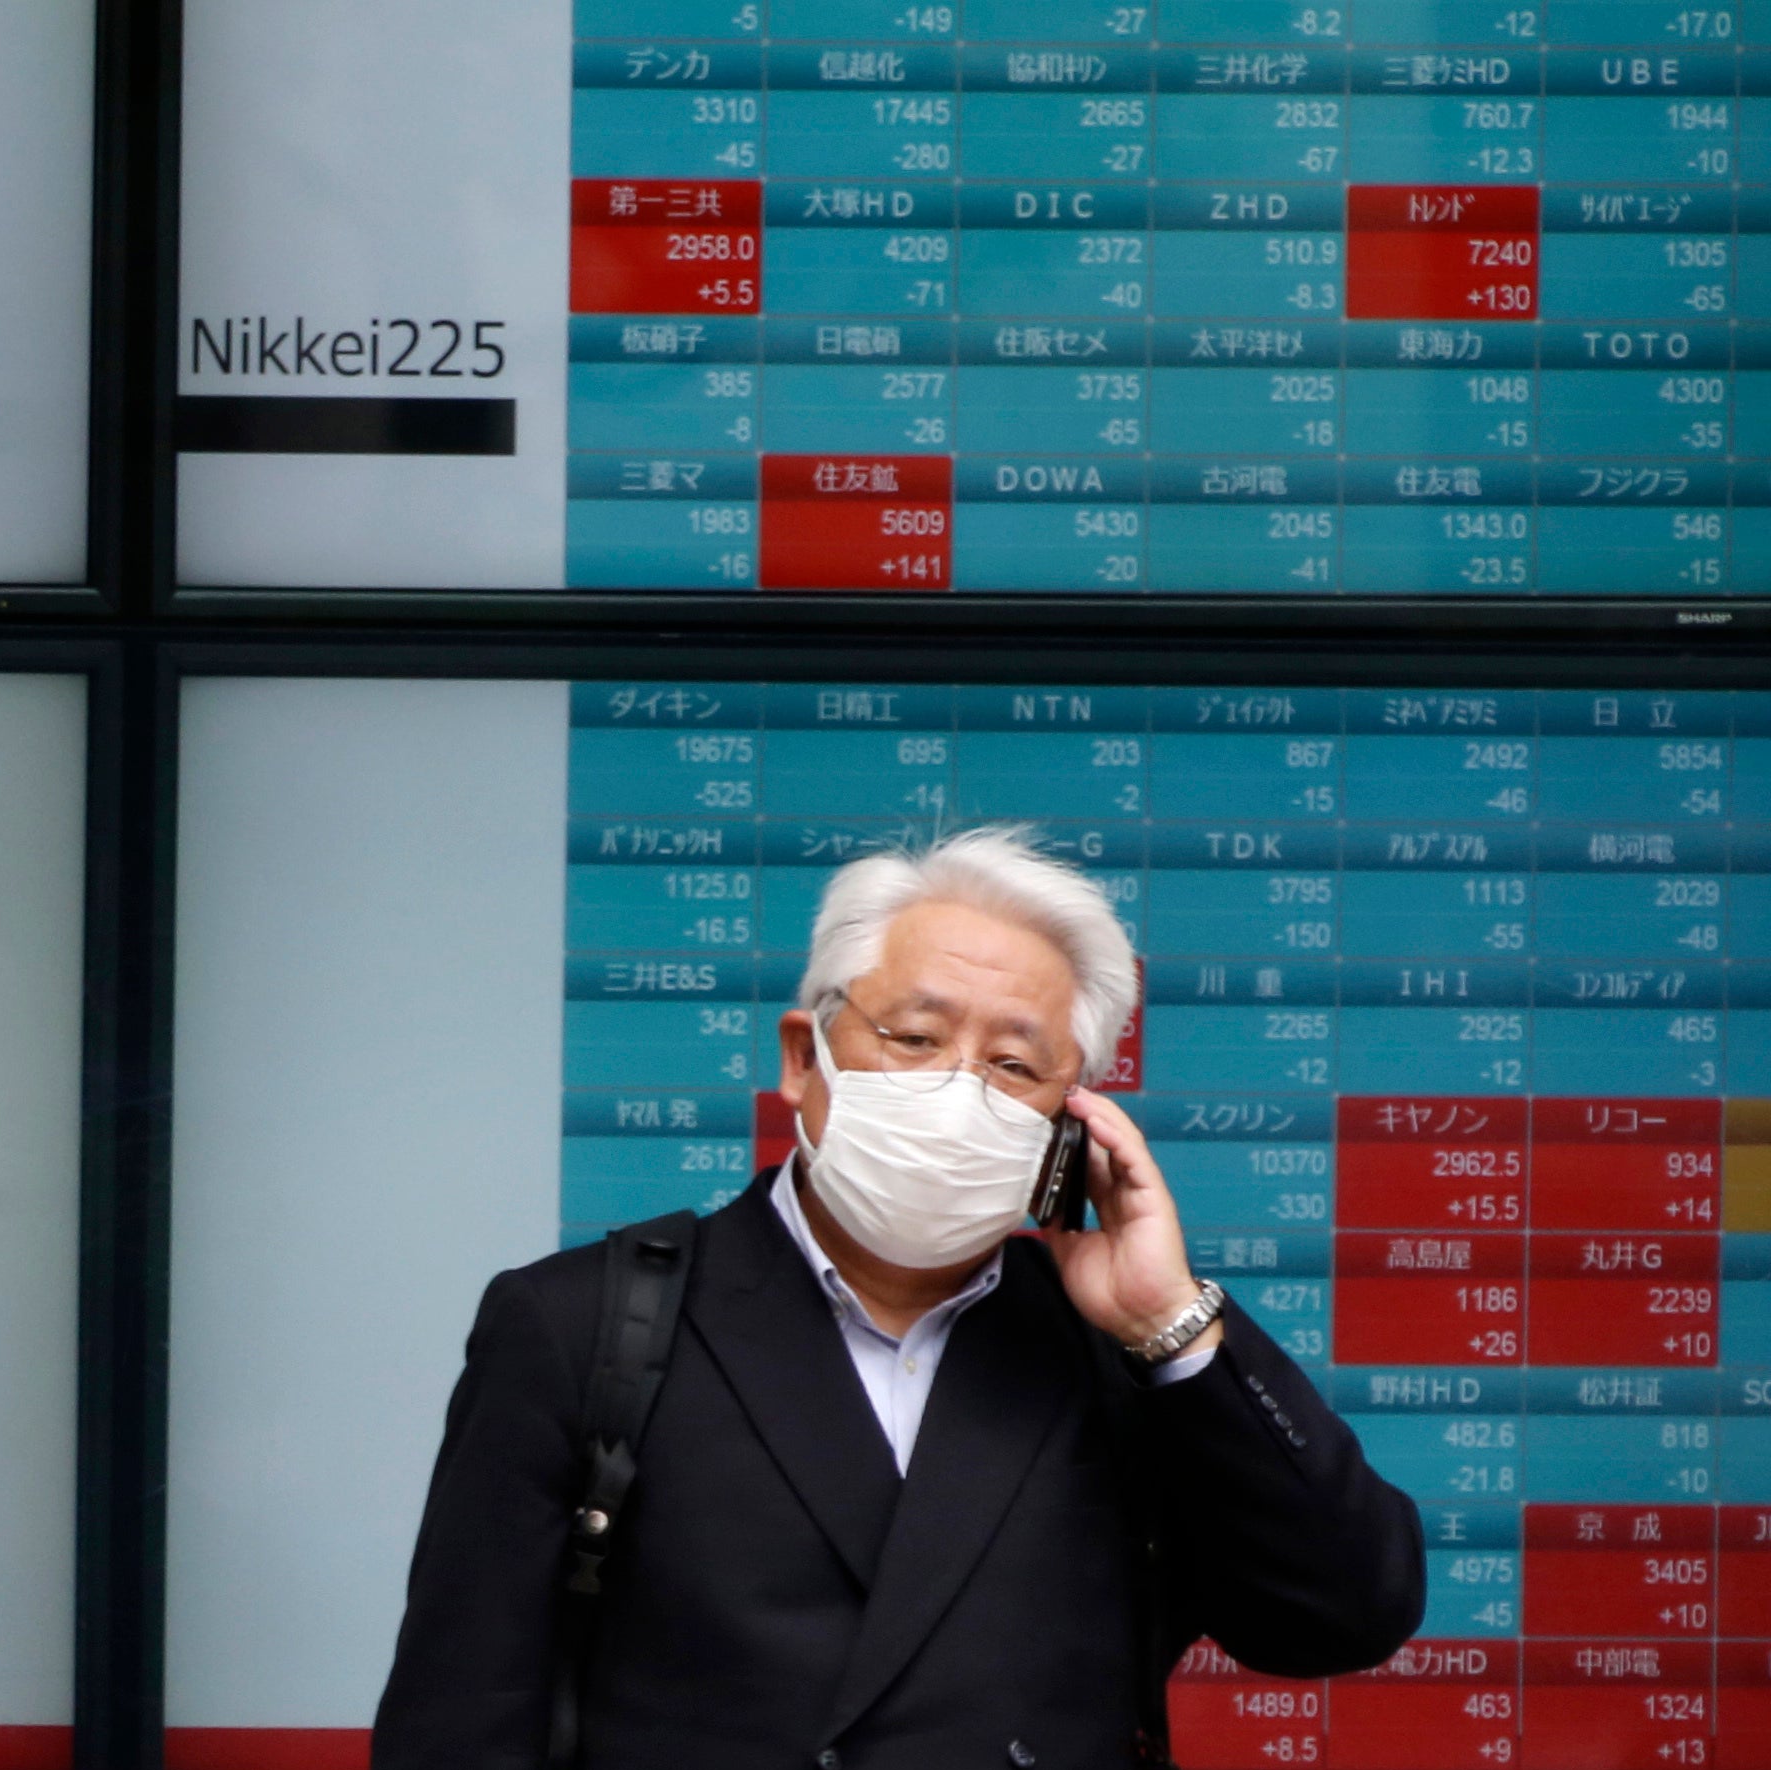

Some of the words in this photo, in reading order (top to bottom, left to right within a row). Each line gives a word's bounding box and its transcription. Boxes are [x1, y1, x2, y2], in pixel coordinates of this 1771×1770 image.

[731, 4, 759, 31] -5
[896, 6, 952, 33] -149
[1105, 7, 1147, 34] -27
[1293, 8, 1341, 36] -8.2
[1495, 10, 1536, 37] -12
[1666, 10, 1731, 38] -17.0
[694, 96, 756, 124] 3310
[875, 98, 950, 126] 17445
[1081, 100, 1144, 127] 2665
[1463, 102, 1534, 129] 760.7
[1668, 103, 1728, 130] 1944
[715, 142, 755, 168] -45
[894, 142, 950, 170] -280
[1102, 144, 1145, 172] -27
[1298, 146, 1339, 173] -67
[1468, 147, 1533, 174] -12.3
[1687, 148, 1729, 175] -10
[668, 234, 754, 260] 2958.0
[885, 235, 948, 262] 4209
[1080, 236, 1142, 264] 2372
[1266, 238, 1338, 265] 510.9
[1469, 240, 1531, 265] 7240
[1666, 240, 1726, 267] 1305
[699, 279, 753, 305] +5.5
[906, 279, 945, 306] -71
[1101, 282, 1142, 308] -40
[1288, 283, 1340, 310] -8.3
[1467, 285, 1530, 310] +130
[1684, 285, 1726, 311] -65
[192, 315, 506, 379] Nikkei225
[705, 371, 752, 398] 385
[882, 372, 944, 400] 2577
[1078, 374, 1140, 401] 3735
[1272, 374, 1334, 402] 2025
[1467, 376, 1529, 403] 1048
[1659, 376, 1724, 404] 4300
[725, 416, 752, 443] -8
[905, 417, 946, 444] -26
[1099, 418, 1140, 445] -65
[1294, 419, 1335, 447] -18
[1487, 420, 1528, 447] -15
[1681, 421, 1723, 448] -35
[691, 507, 750, 534] 1983
[882, 509, 944, 535] 5609
[1076, 509, 1138, 537] 5430
[1270, 511, 1332, 539] 2045
[1442, 512, 1526, 539] 1343.0
[1674, 513, 1721, 541] 546
[708, 552, 753, 579] -16
[881, 555, 940, 579] +141
[1096, 555, 1138, 582] -20
[1461, 556, 1526, 584] -23.5
[1679, 558, 1721, 584] -15
[1676, 611, 1733, 624] SHARP
[897, 737, 946, 765] 695
[1092, 739, 1140, 767] 203
[1464, 742, 1528, 770] 2492
[1660, 743, 1721, 770] 5854
[1293, 786, 1334, 812] -15
[1486, 786, 1527, 813] -46
[1681, 788, 1720, 815] -54
[665, 872, 750, 899] 1125.0
[1269, 875, 1331, 904] 3795
[1464, 879, 1525, 906] 1113
[684, 916, 749, 944] -16.5
[1275, 922, 1331, 948] -150
[1483, 923, 1524, 950] -55
[700, 1009, 748, 1035] 342
[1266, 1013, 1328, 1040] 2265
[1460, 1015, 1522, 1042] 2925
[1668, 1016, 1716, 1042] 465
[721, 1053, 747, 1079] -8
[1286, 1057, 1328, 1084] -12
[1481, 1058, 1521, 1086] -12
[1689, 1060, 1716, 1086] -3
[681, 1146, 745, 1171] 2612
[1434, 1151, 1520, 1176] 2962.5
[1666, 1152, 1713, 1178] 934
[1268, 1196, 1326, 1220] -330
[1448, 1195, 1519, 1220] +15.5
[1666, 1197, 1712, 1221] +14
[1457, 1287, 1517, 1312] 1186
[1649, 1287, 1711, 1313] 2239
[1470, 1331, 1516, 1356] +26
[1664, 1332, 1710, 1357] +10
[1443, 1421, 1515, 1448] 482.6
[1661, 1422, 1709, 1450] 818
[1450, 1465, 1514, 1492] -21.8
[1668, 1467, 1709, 1493] -10
[1449, 1559, 1514, 1583] 4975
[1645, 1559, 1707, 1584] 3405
[1472, 1603, 1513, 1627] -45
[1660, 1603, 1706, 1628] +10
[1233, 1692, 1318, 1717] 1489.0
[1464, 1693, 1511, 1718] 463
[1646, 1694, 1704, 1720] 1324
[1262, 1736, 1317, 1762] +8.5
[1479, 1737, 1511, 1763] +9
[1658, 1739, 1705, 1764] +13
